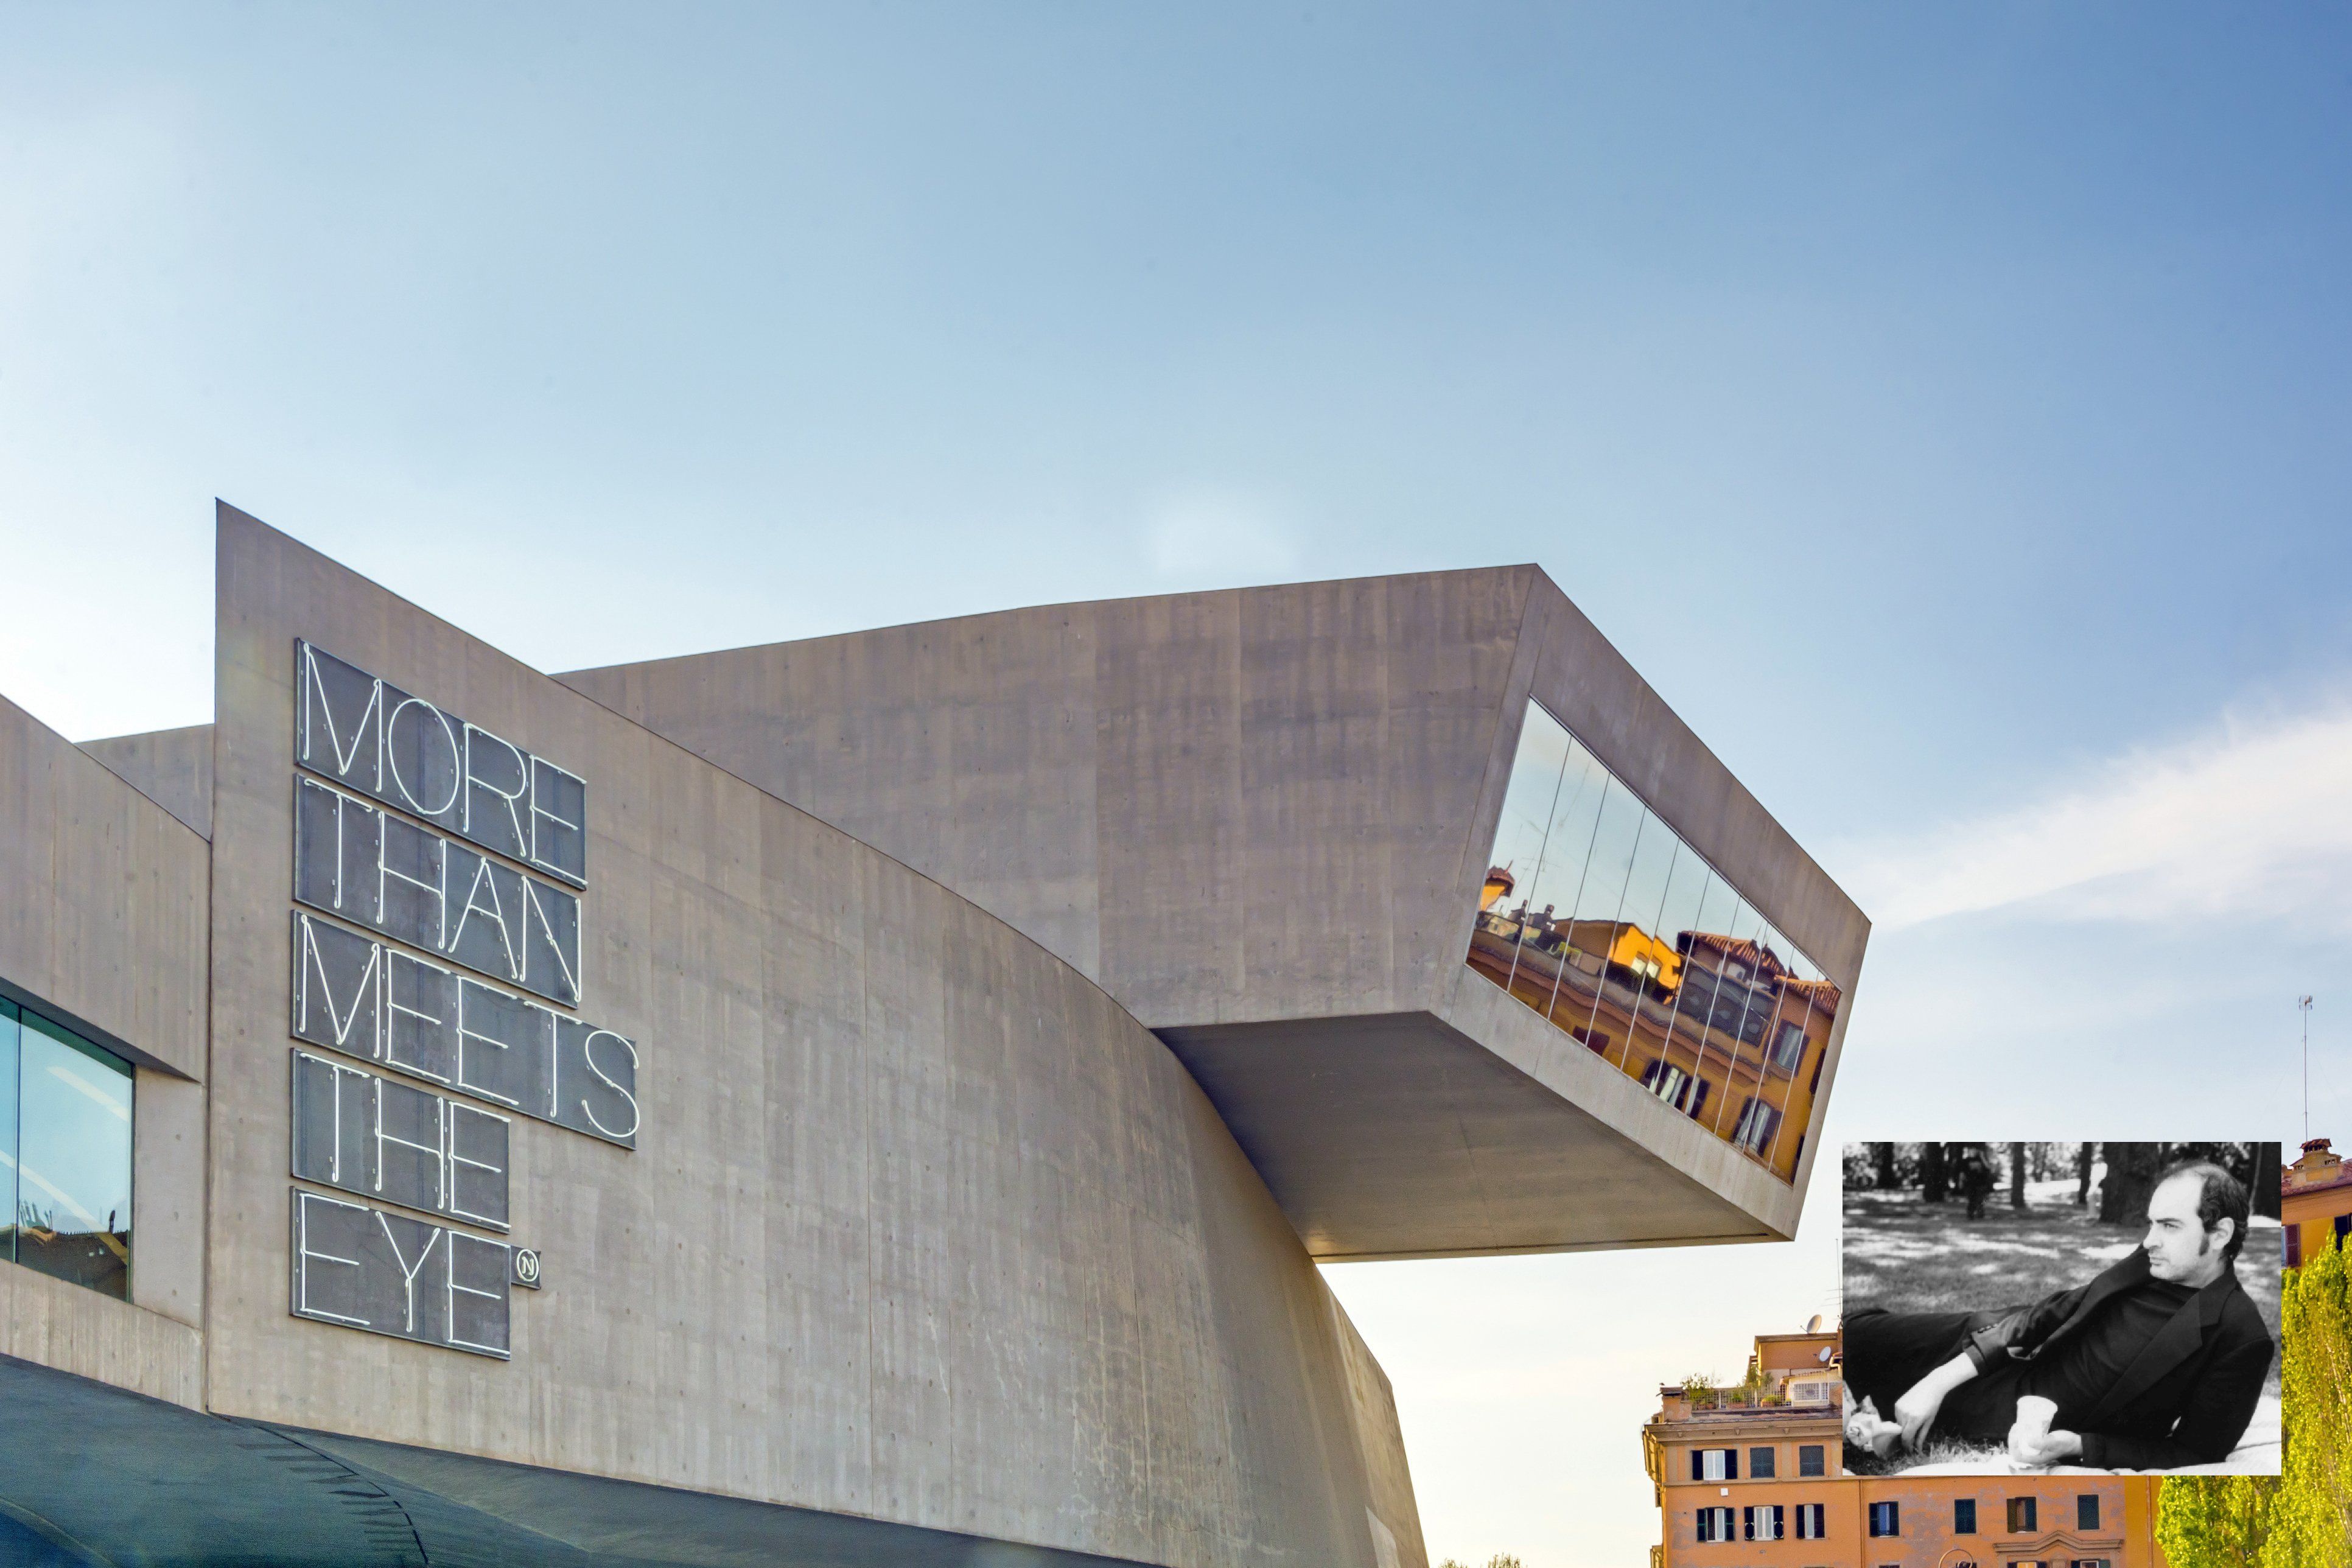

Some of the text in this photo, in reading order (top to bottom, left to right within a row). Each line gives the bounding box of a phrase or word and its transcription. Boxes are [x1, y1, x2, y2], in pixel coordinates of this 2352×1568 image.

[303, 643, 589, 886] MORE
[304, 777, 581, 1003] THAN
[299, 914, 640, 1138] MEETS
[299, 1052, 512, 1229] THE
[299, 1192, 511, 1356] EYE
